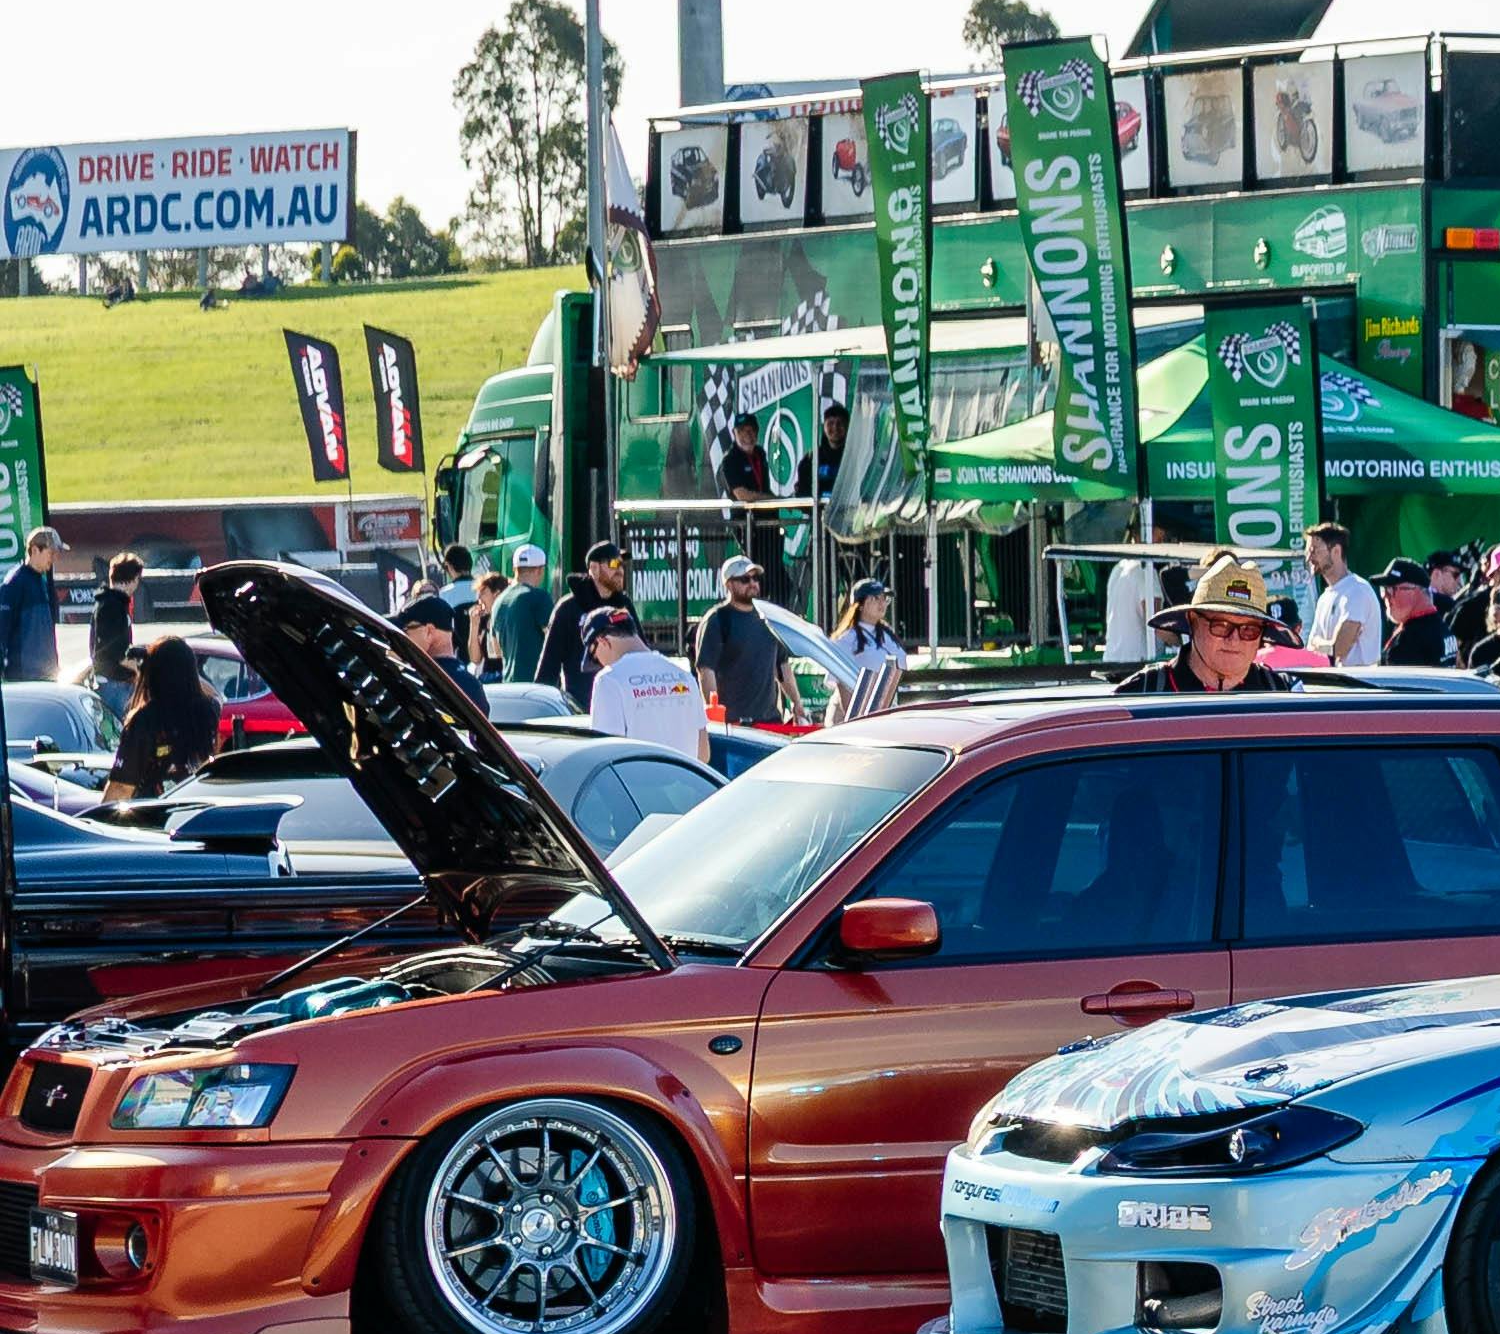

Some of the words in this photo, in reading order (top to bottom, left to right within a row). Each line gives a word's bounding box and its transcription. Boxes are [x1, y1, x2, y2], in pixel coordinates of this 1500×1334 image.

[79, 152, 154, 185] DRIVE
[172, 147, 233, 179] RIDE
[250, 142, 339, 174] WATCH
[80, 183, 339, 239] ARDC.COM.AU
[1088, 152, 1114, 261] ENTHUSIASTS
[1291, 265, 1331, 278] SUPPORTED
[1024, 155, 1114, 472] SHANNONS
[1095, 262, 1119, 347] MOTORING
[1365, 318, 1380, 341] Jim
[1381, 314, 1421, 338] Richards
[741, 359, 811, 412] SHANNONS
[1102, 349, 1122, 383] FOR
[305, 343, 341, 462] ADVAN
[382, 342, 409, 457] ADVAN
[1105, 385, 1129, 475] INSURANCE
[956, 467, 977, 485] JOIN
[978, 467, 997, 484] THE
[998, 466, 1052, 485] SHANNONS
[1324, 460, 1425, 479] MOTORING
[628, 670, 687, 686] ORACLE
